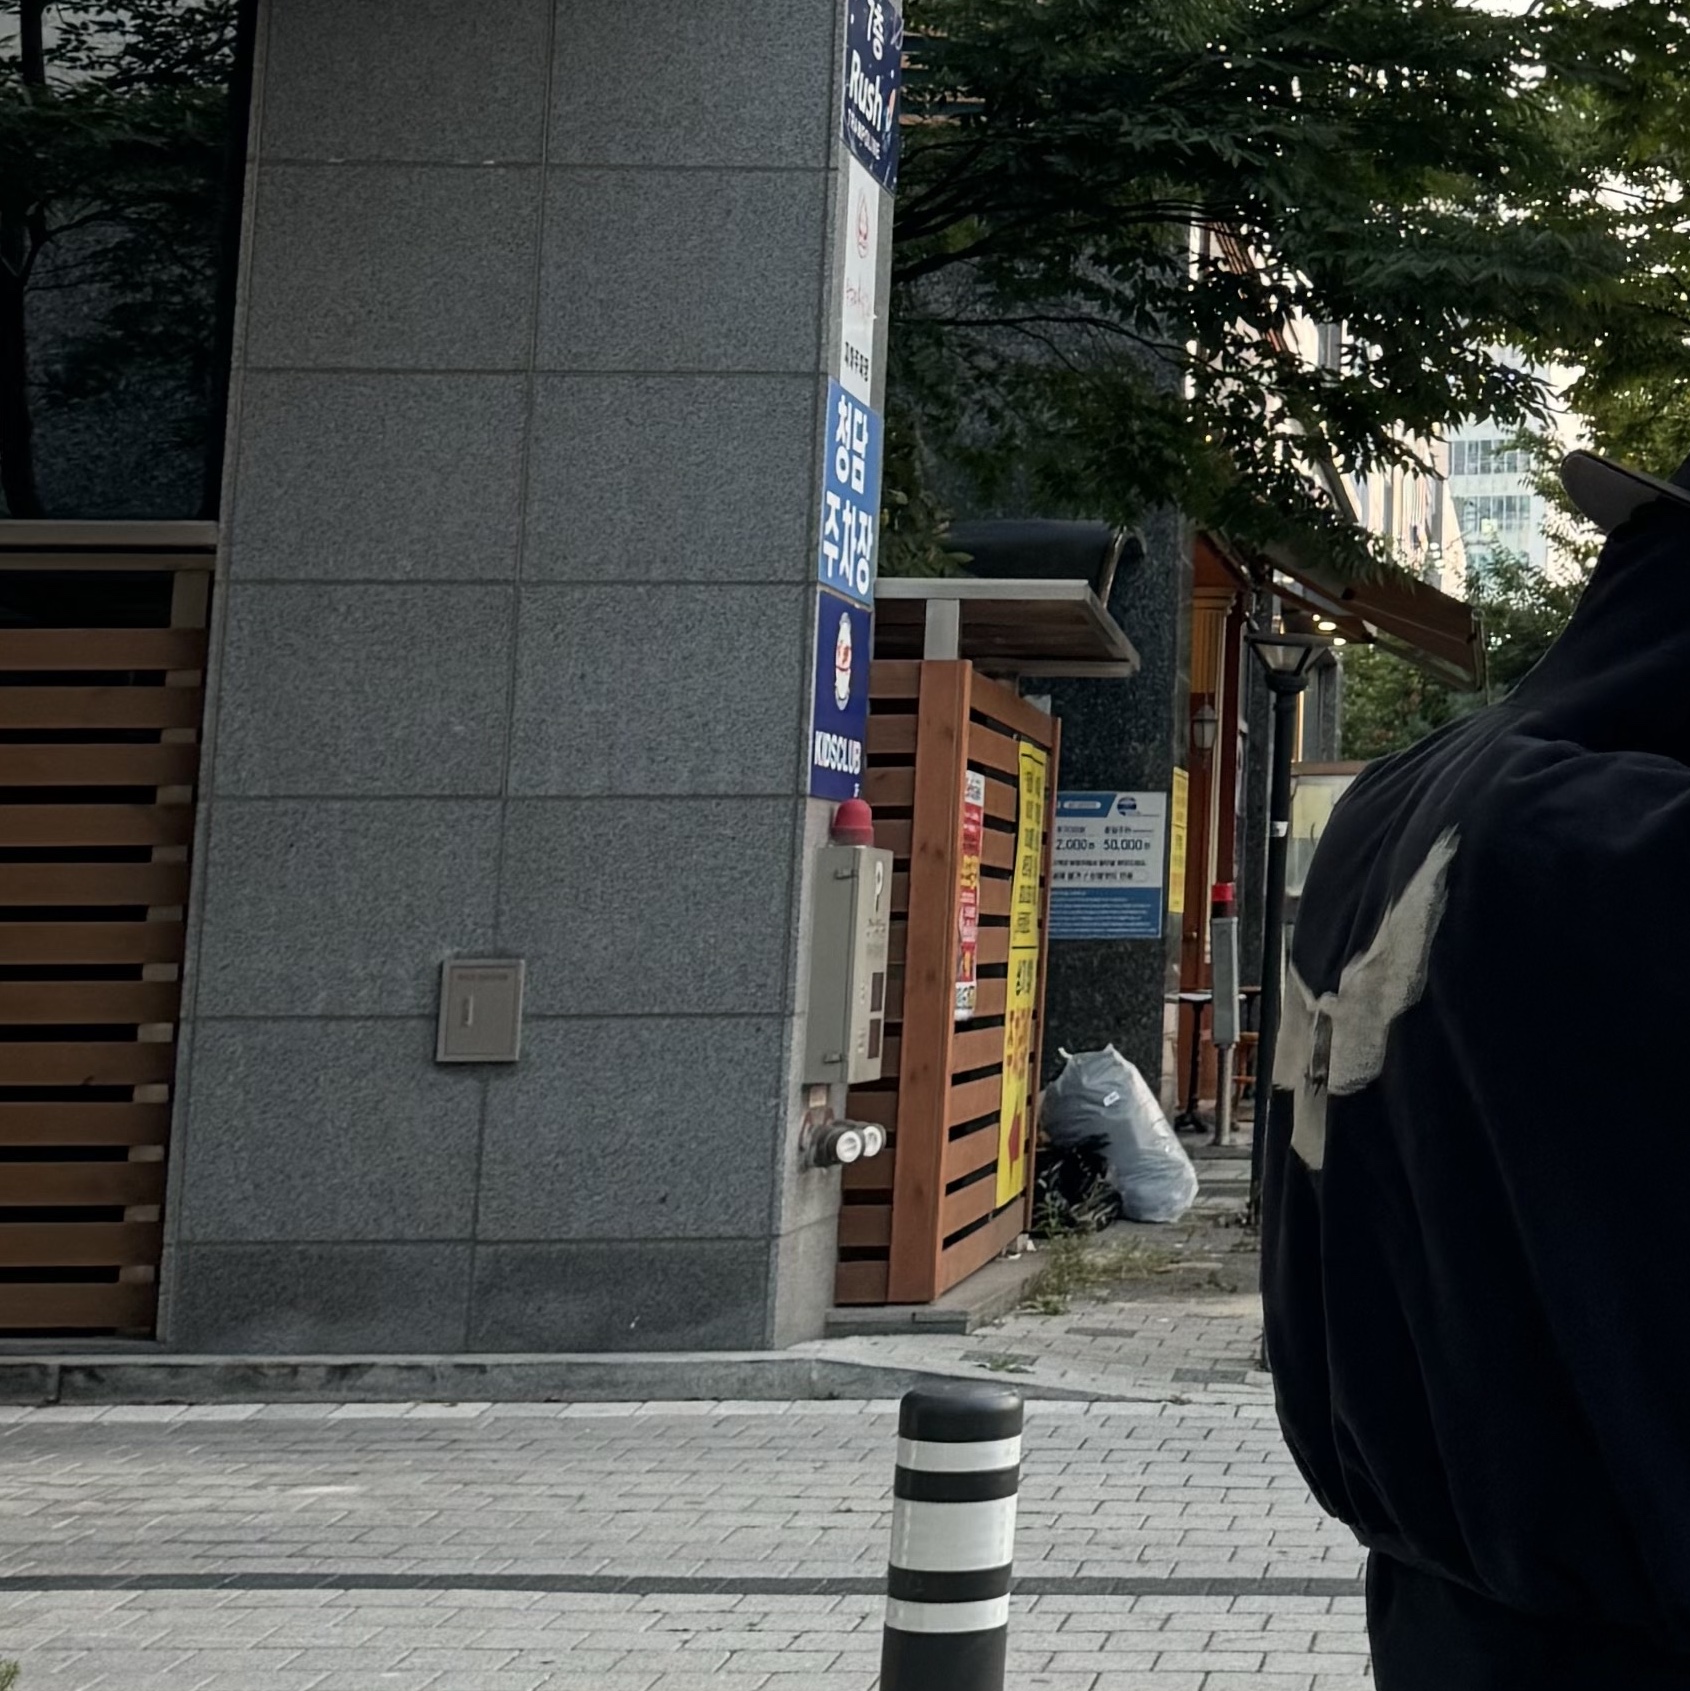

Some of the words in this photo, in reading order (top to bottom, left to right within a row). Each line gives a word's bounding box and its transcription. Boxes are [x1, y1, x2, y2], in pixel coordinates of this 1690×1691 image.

[848, 50, 883, 131] Rush
[835, 394, 869, 494] 청담
[823, 490, 873, 595] 주차장
[813, 730, 861, 775] KIDSCLUB
